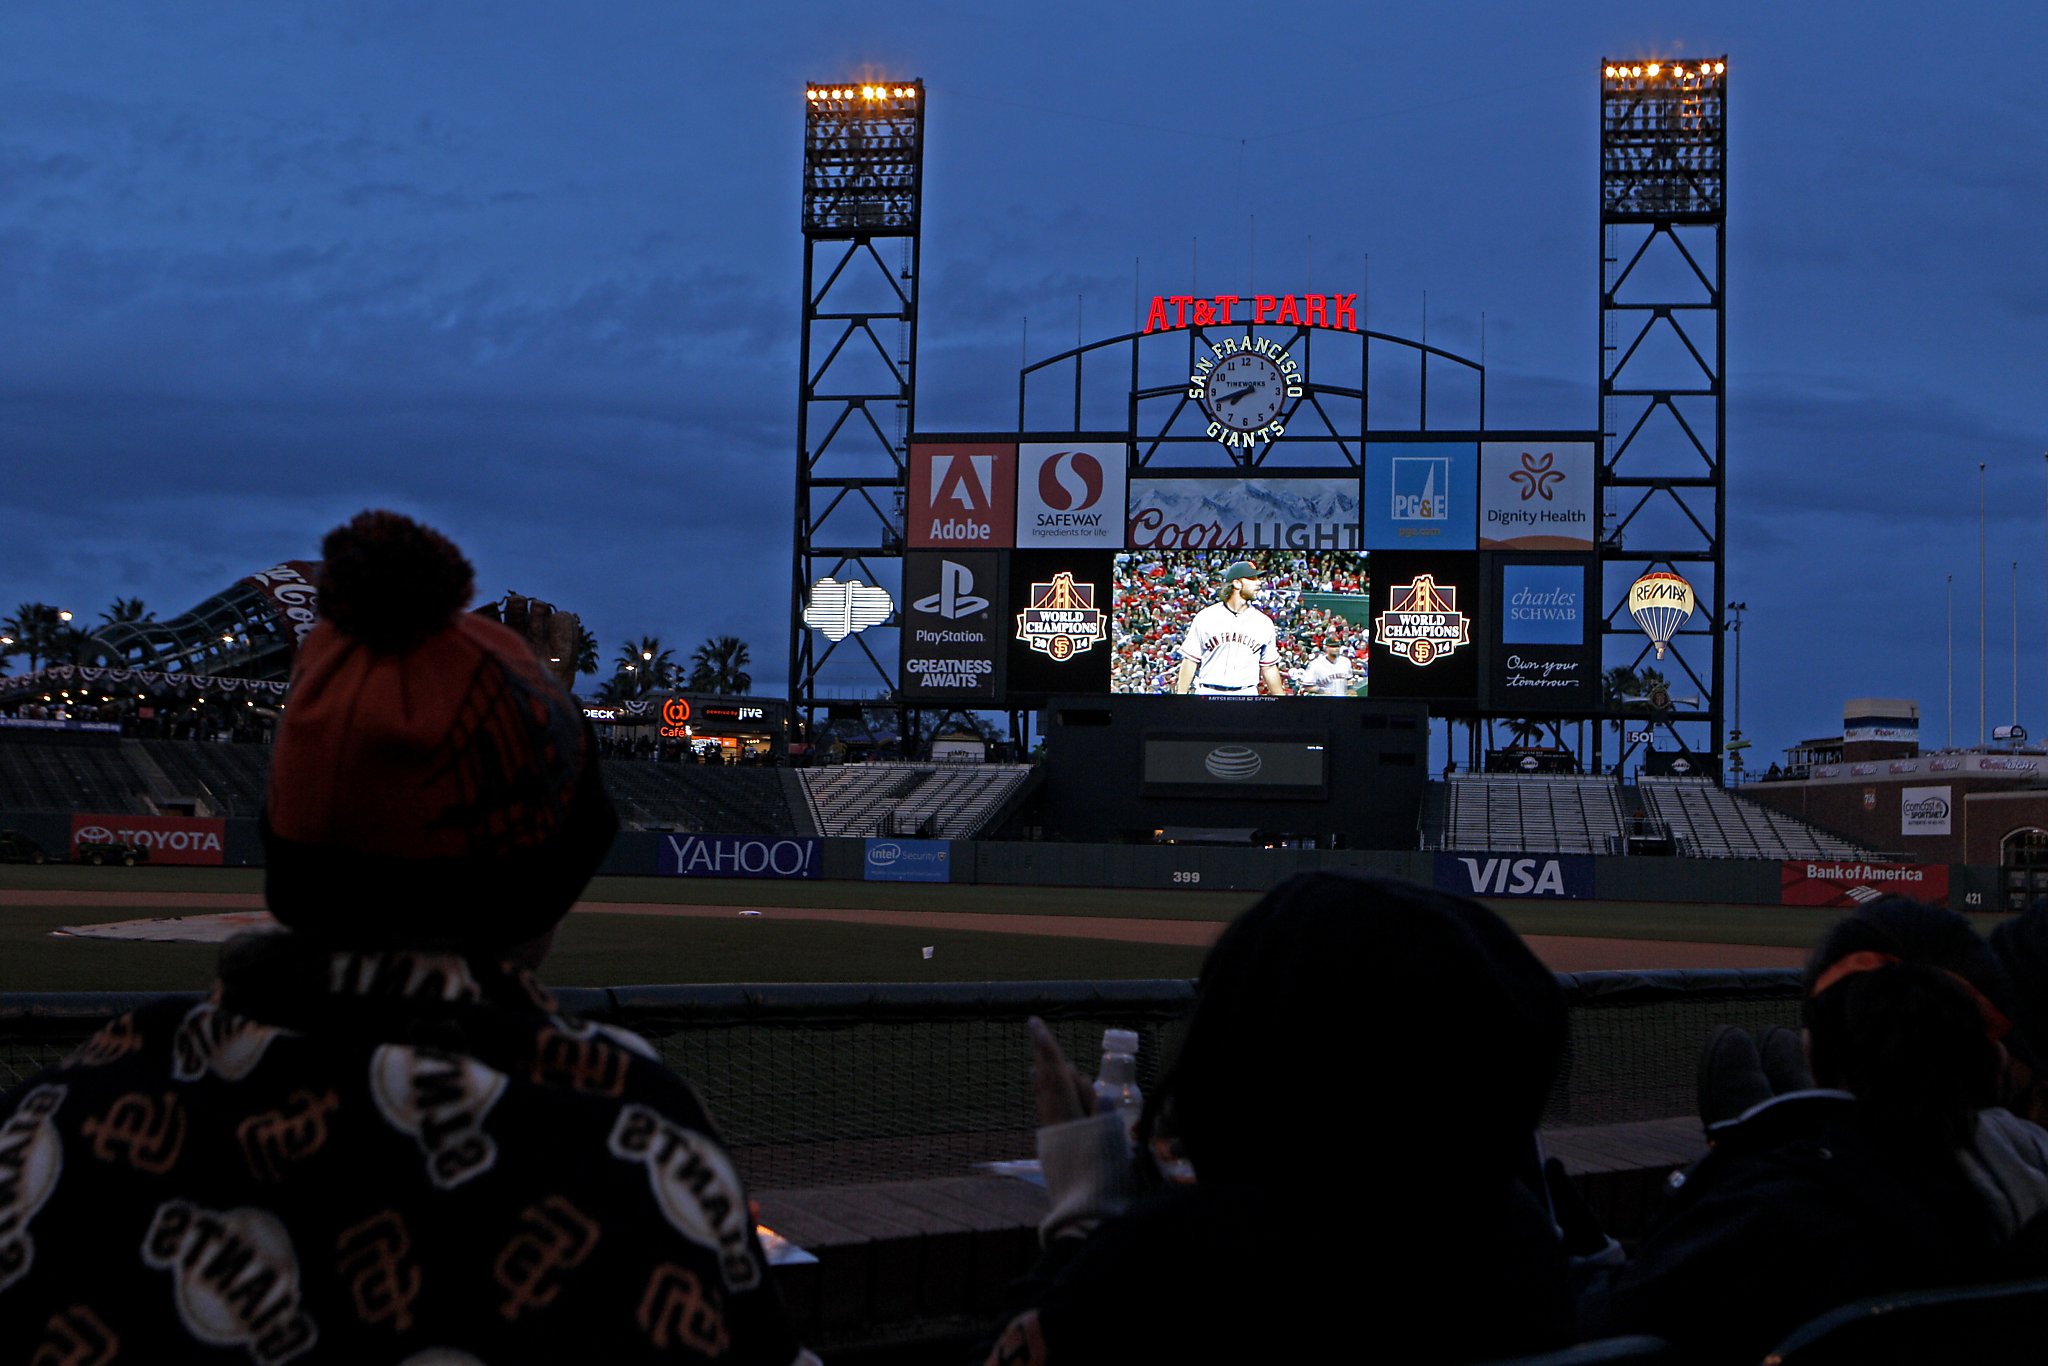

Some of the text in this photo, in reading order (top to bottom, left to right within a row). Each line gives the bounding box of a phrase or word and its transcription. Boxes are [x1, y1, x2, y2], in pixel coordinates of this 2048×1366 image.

[1142, 294, 1358, 335] AT&T PARK
[1189, 335, 1302, 399] SAN FRANCISCO
[1228, 362, 1235, 370] 11
[1241, 358, 1251, 366] 12
[1260, 362, 1264, 370] 1
[1216, 373, 1226, 381] 10
[1270, 372, 1276, 380] 2
[1211, 388, 1217, 396] 9
[1275, 387, 1281, 396] 3
[1269, 403, 1275, 411] 4
[1228, 413, 1234, 421] 7
[1242, 418, 1248, 426] 6
[1258, 413, 1264, 421] 5
[1206, 420, 1285, 448] GIANTS
[1395, 495, 1446, 518] PG&E
[1037, 513, 1103, 526] SAFEWAY
[1488, 509, 1586, 526] Dignity Health
[930, 518, 991, 540] Adobe
[1032, 528, 1107, 538] Ingredients for life
[1129, 507, 1360, 550] Coors LIGHT
[1512, 587, 1576, 606] charles
[1637, 583, 1687, 603] RE/MAX
[1040, 611, 1084, 622] WORLD
[1400, 615, 1446, 626] WORLD
[1511, 608, 1576, 620] SCHWAB
[1026, 622, 1097, 634] CHAMPIONS
[1385, 625, 1460, 638] CHAMPIONS
[916, 630, 984, 645] PlayStation
[1034, 637, 1047, 648] 20
[1076, 637, 1088, 648] 14
[1394, 641, 1406, 652] 20
[1438, 641, 1450, 652] 14
[906, 659, 993, 674] GREATNESS
[1506, 655, 1578, 676] Own your
[921, 674, 978, 688] AWAITS
[1506, 674, 1579, 687] tomorrow
[738, 707, 763, 721] jive
[660, 726, 686, 738] Café
[118, 829, 222, 851] TOYOTA
[667, 835, 814, 877] YAHOO!
[872, 848, 937, 862] intel Security
[1173, 871, 1200, 883] 399
[1457, 857, 1565, 895] VISA
[1806, 865, 1924, 881] Bank of America
[1965, 892, 1982, 905] 421
